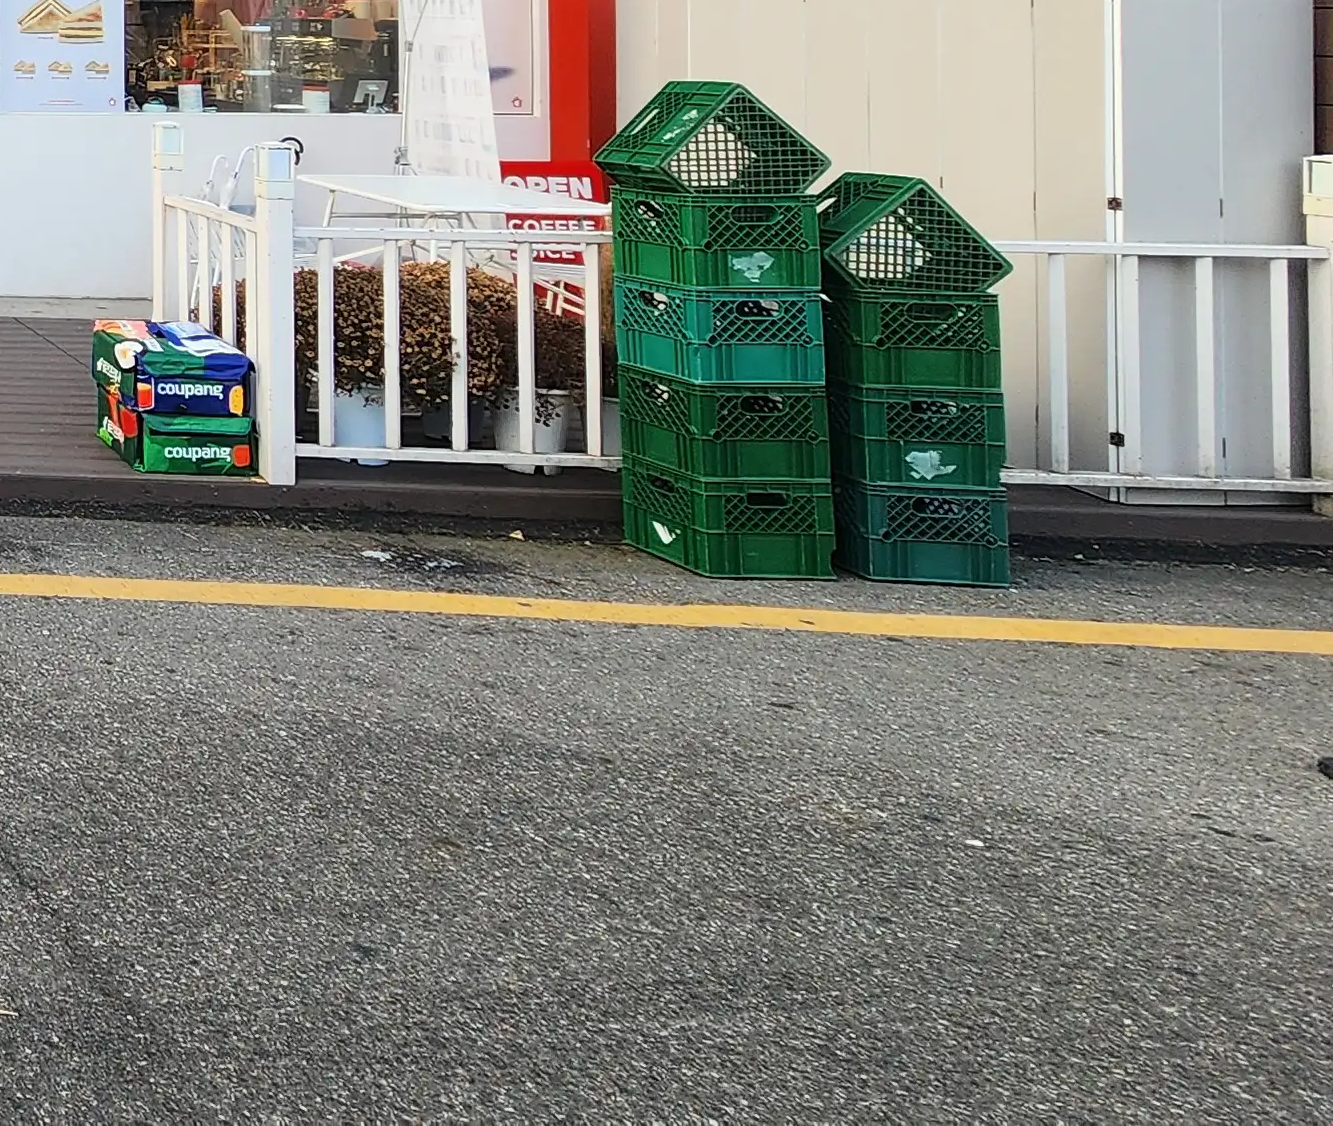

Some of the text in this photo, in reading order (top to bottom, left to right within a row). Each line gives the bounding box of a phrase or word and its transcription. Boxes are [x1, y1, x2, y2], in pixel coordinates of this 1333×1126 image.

[503, 176, 593, 200] OPEN
[157, 382, 224, 400] coupang
[164, 446, 231, 462] coupang
